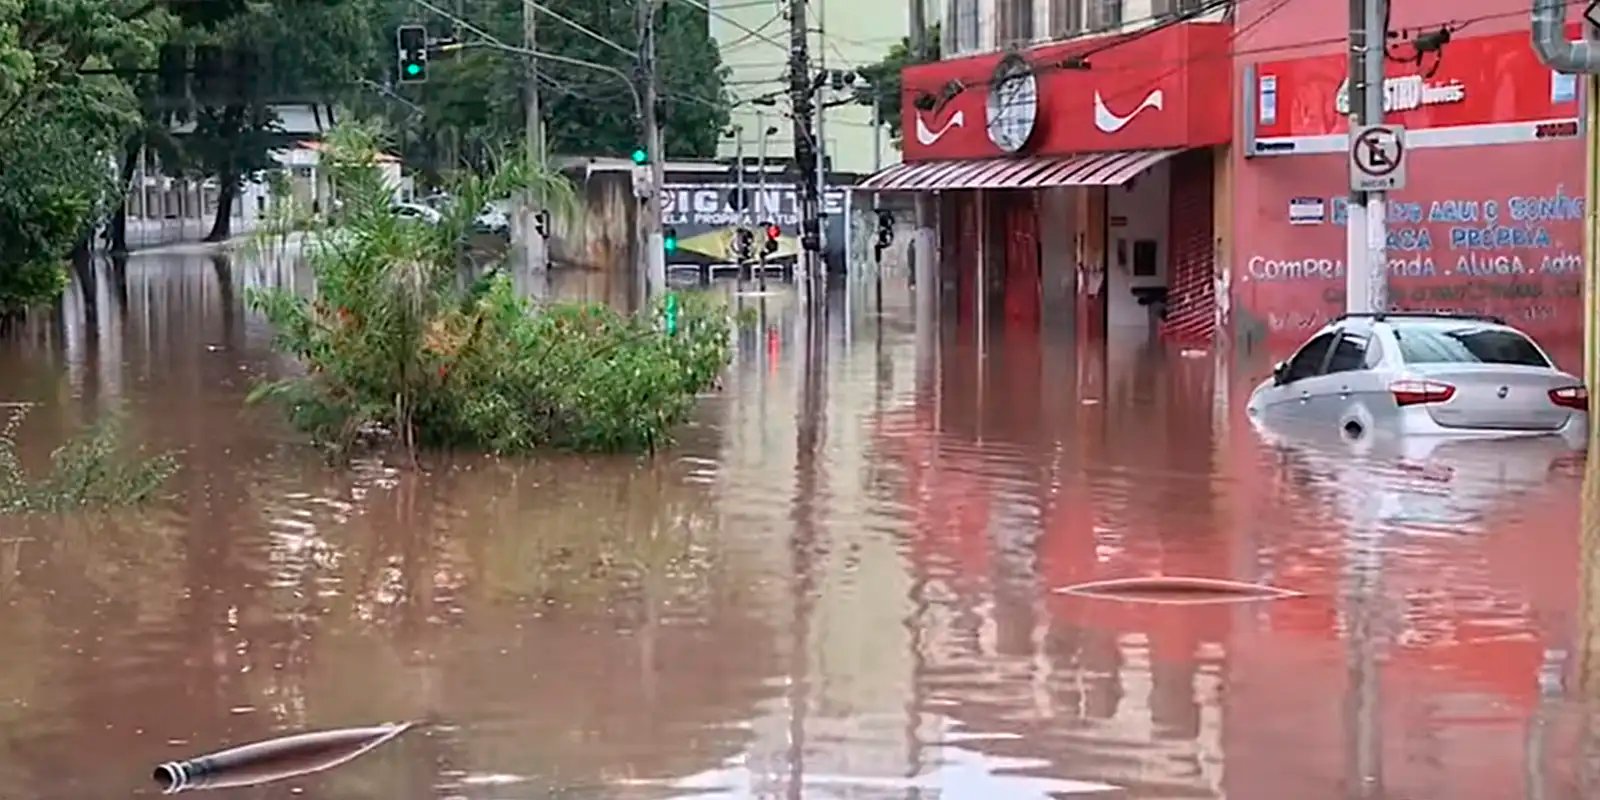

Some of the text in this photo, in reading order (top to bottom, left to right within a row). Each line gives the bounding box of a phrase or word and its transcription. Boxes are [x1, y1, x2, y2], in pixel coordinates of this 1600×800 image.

[661, 190, 844, 213] IGNTE
[1428, 200, 1479, 222] AQUI
[1484, 199, 1499, 221] O
[1386, 227, 1432, 250] ASA
